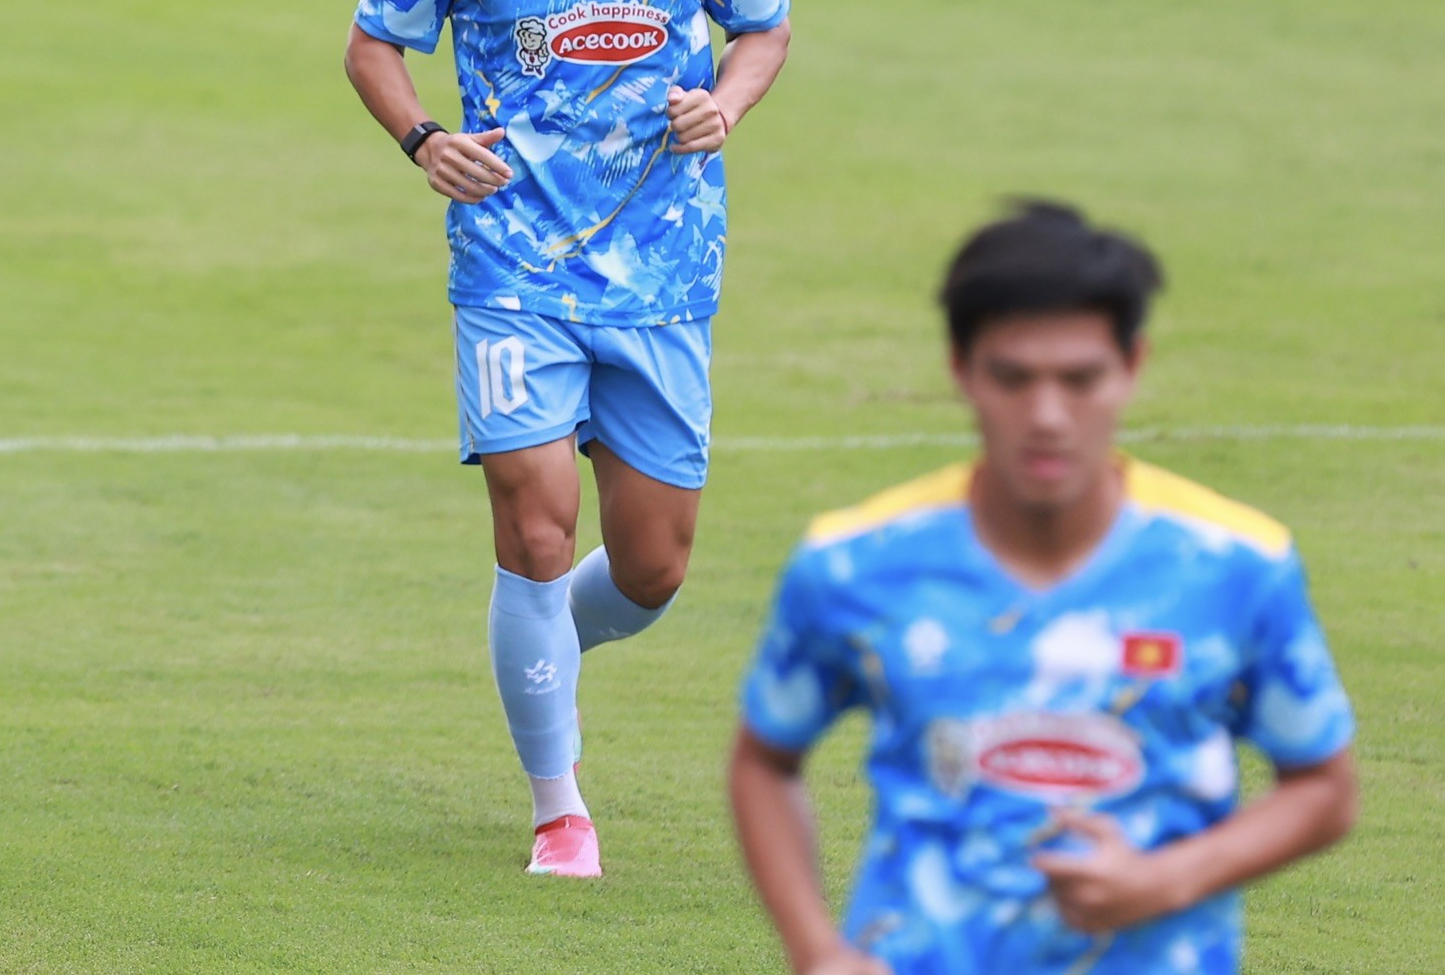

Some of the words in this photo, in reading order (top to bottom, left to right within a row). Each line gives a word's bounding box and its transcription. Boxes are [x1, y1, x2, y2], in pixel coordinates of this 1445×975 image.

[548, 7, 586, 30] Cook
[591, 4, 668, 24] happiness
[476, 335, 529, 419] 10
